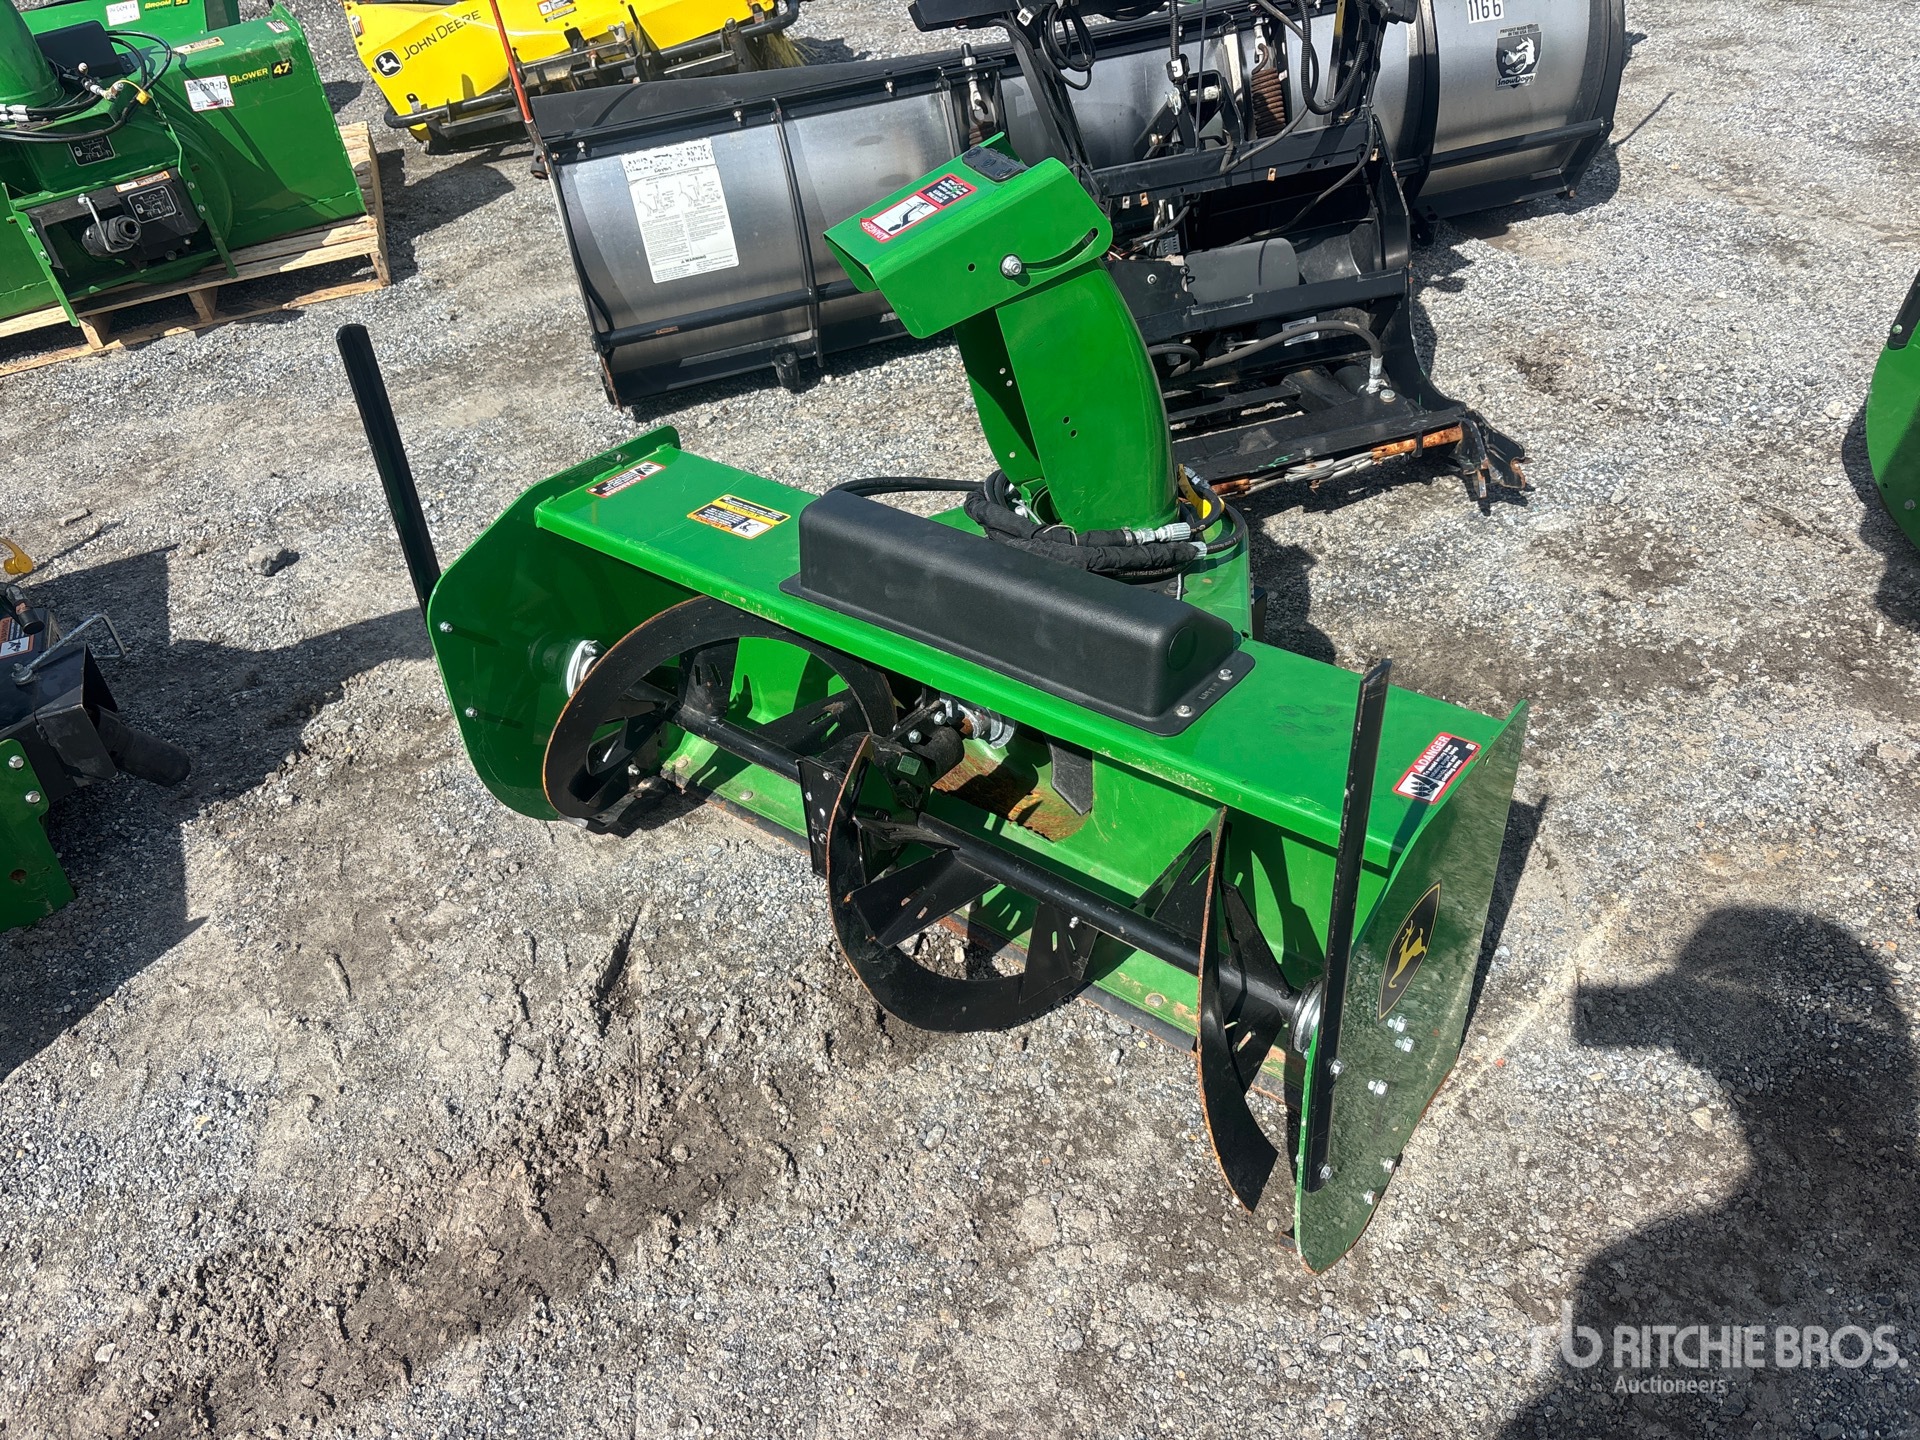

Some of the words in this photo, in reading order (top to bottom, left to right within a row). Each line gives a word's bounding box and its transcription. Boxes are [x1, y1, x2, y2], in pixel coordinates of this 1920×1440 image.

[404, 33, 437, 60] JOHN
[436, 10, 481, 40] DEERE
[230, 68, 268, 84] BLOWER
[273, 62, 290, 74] 47
[1498, 75, 1534, 86] SnowDogg
[862, 222, 884, 240] DANGER
[604, 479, 637, 496] DANGER
[1418, 736, 1450, 766] DANGER
